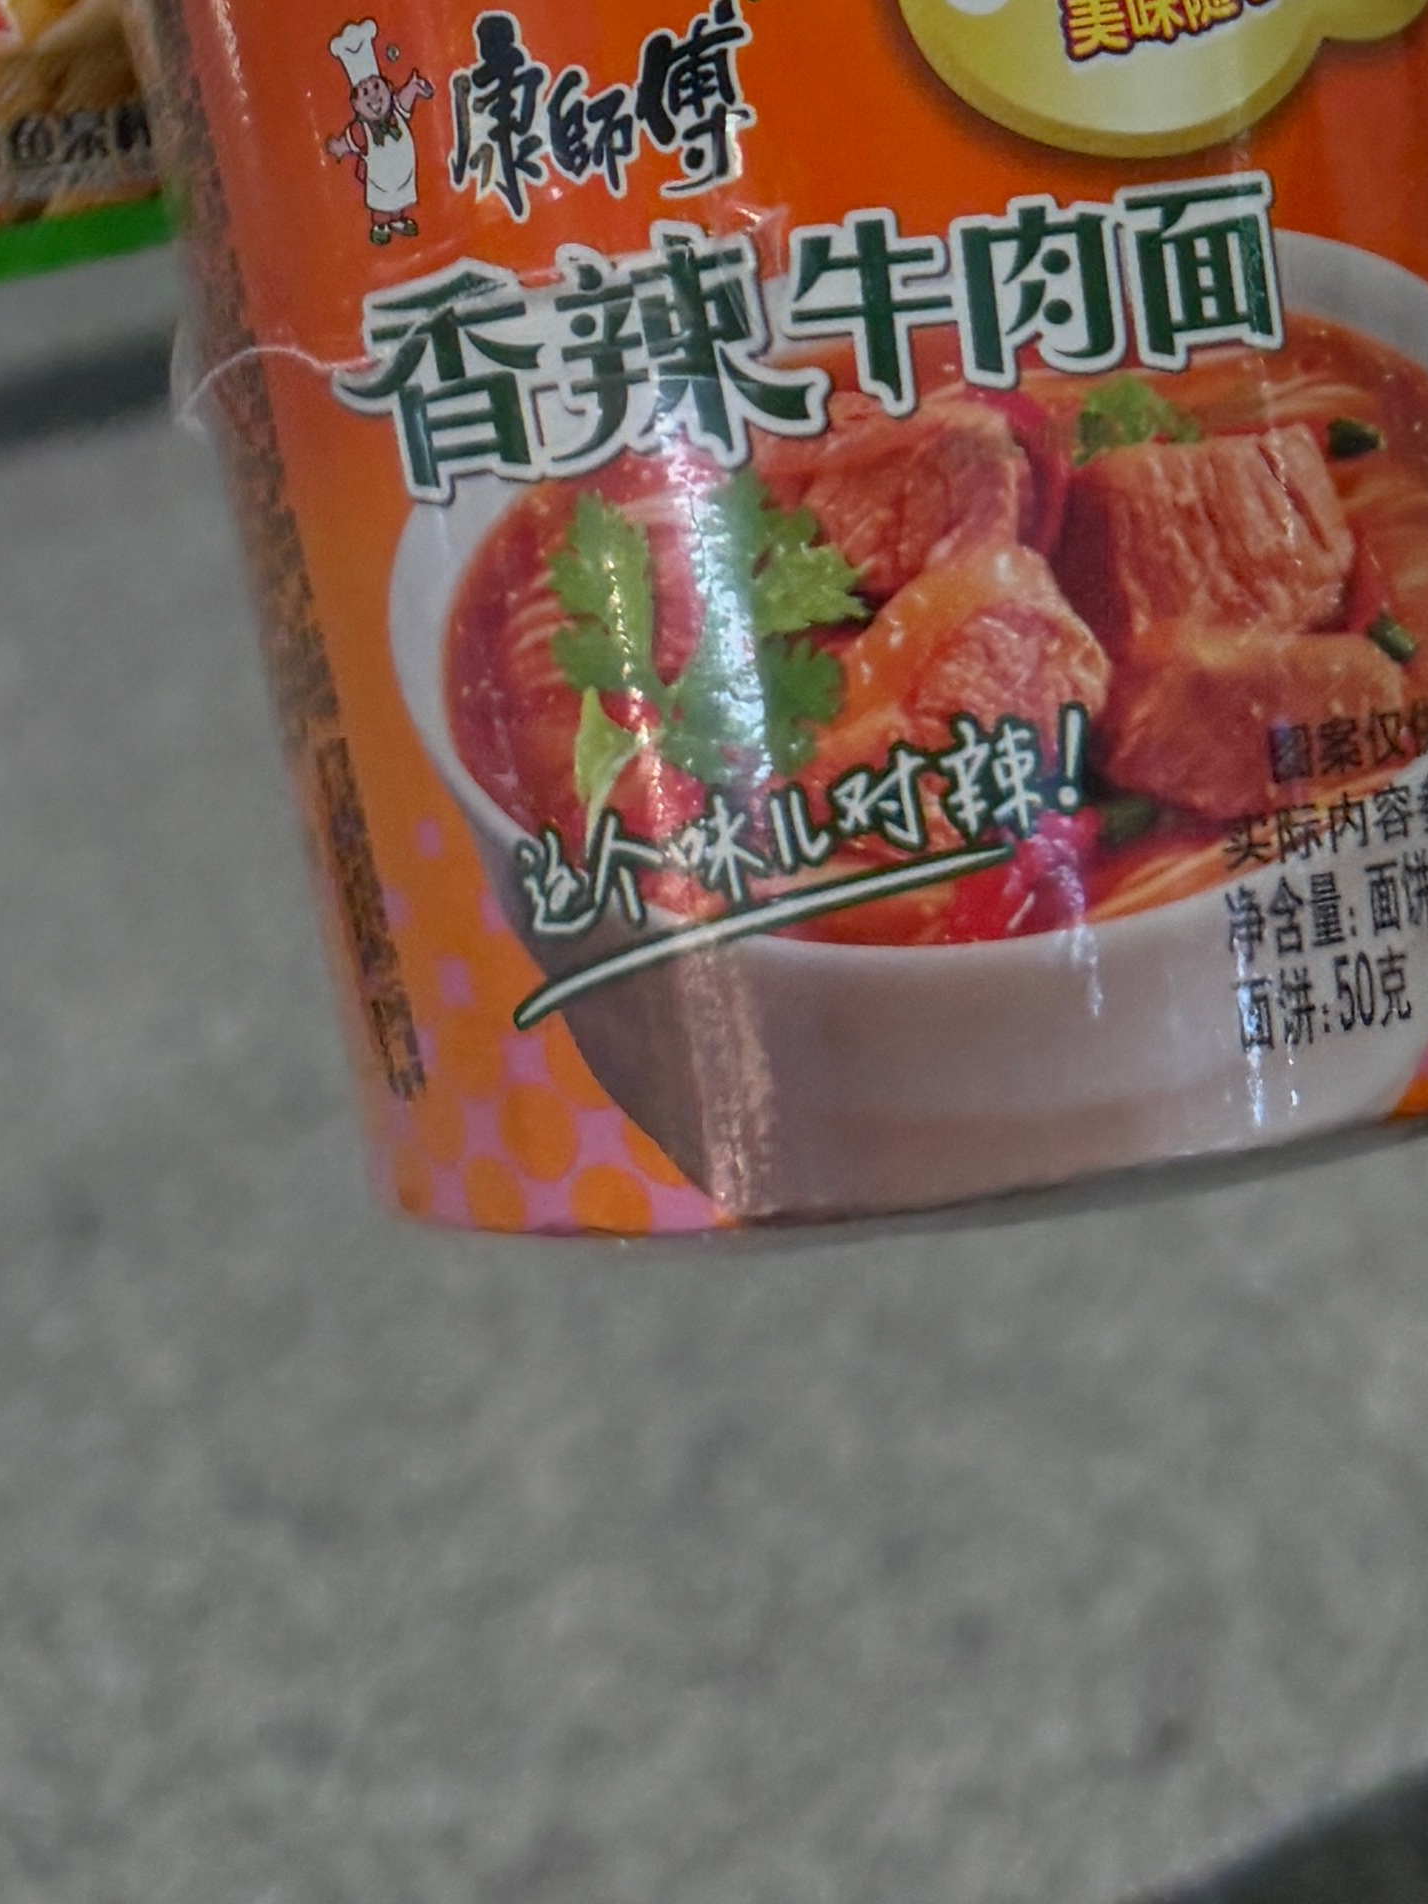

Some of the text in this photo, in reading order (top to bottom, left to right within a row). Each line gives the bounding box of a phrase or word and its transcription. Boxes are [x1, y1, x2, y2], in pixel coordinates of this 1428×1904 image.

[332, 169, 1287, 505] 香辣牛肉面
[516, 701, 1090, 940] 这个味儿对辣!
